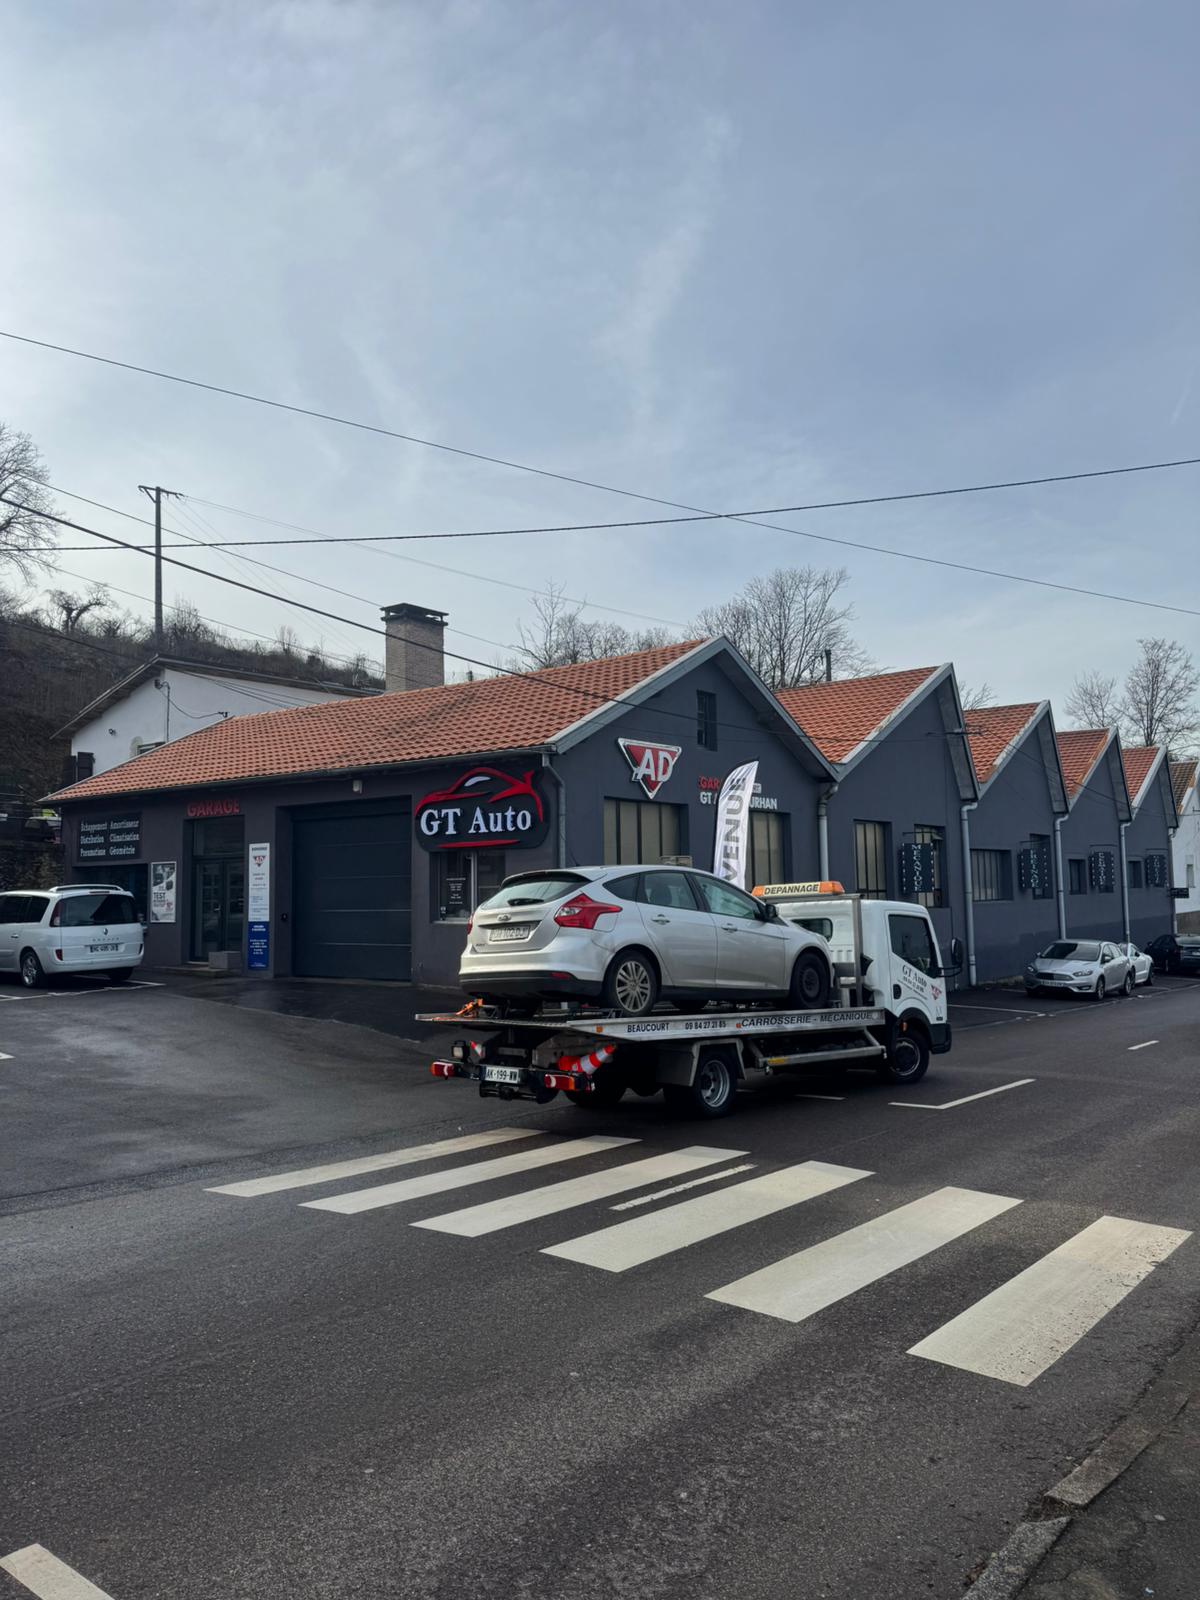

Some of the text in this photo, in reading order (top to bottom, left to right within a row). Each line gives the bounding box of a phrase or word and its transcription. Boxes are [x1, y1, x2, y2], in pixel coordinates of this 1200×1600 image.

[634, 749, 673, 782] AD
[699, 776, 721, 790] GAR
[700, 791, 712, 804] GT
[187, 799, 240, 816] GARAGE
[420, 806, 532, 835] GT Auto
[764, 884, 819, 895] DEPANNAGE
[627, 1022, 669, 1033] BEAUCOURT
[741, 1015, 811, 1027] CARROSSERIE
